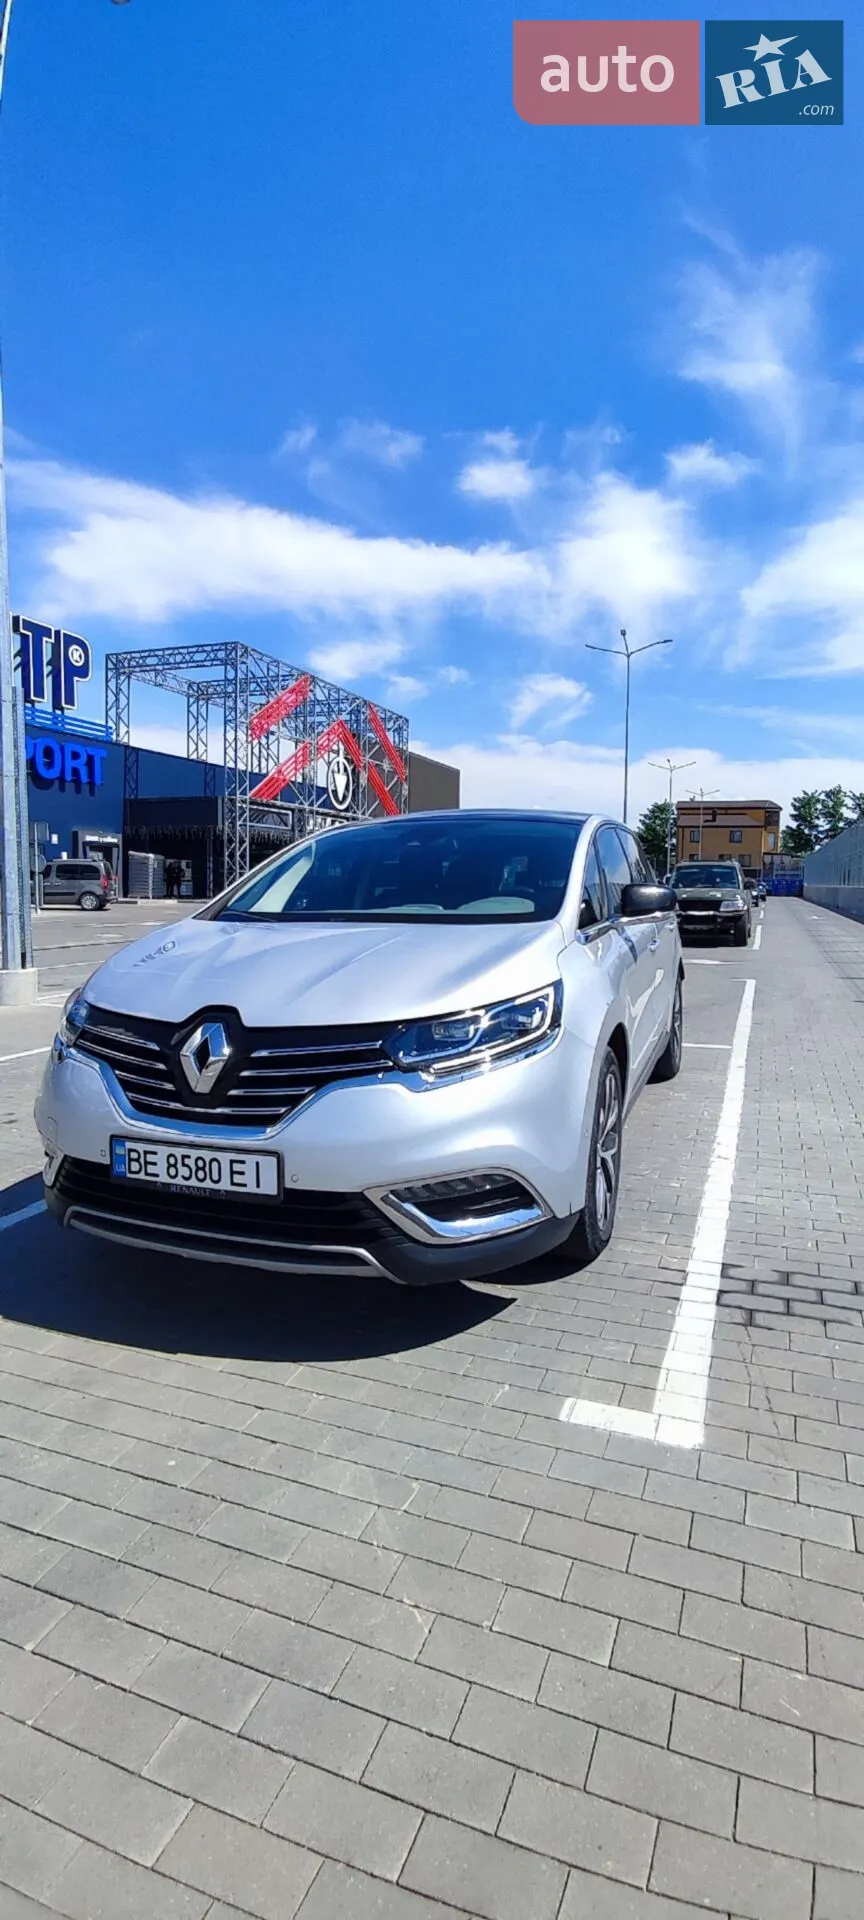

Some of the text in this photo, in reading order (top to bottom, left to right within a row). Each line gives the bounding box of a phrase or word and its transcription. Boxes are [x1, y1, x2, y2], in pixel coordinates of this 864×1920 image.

[10, 612, 91, 710] TP
[115, 1164, 126, 1173] UA
[127, 1148, 261, 1189] BE 8580 EI
[170, 1185, 211, 1197] RENAULT
